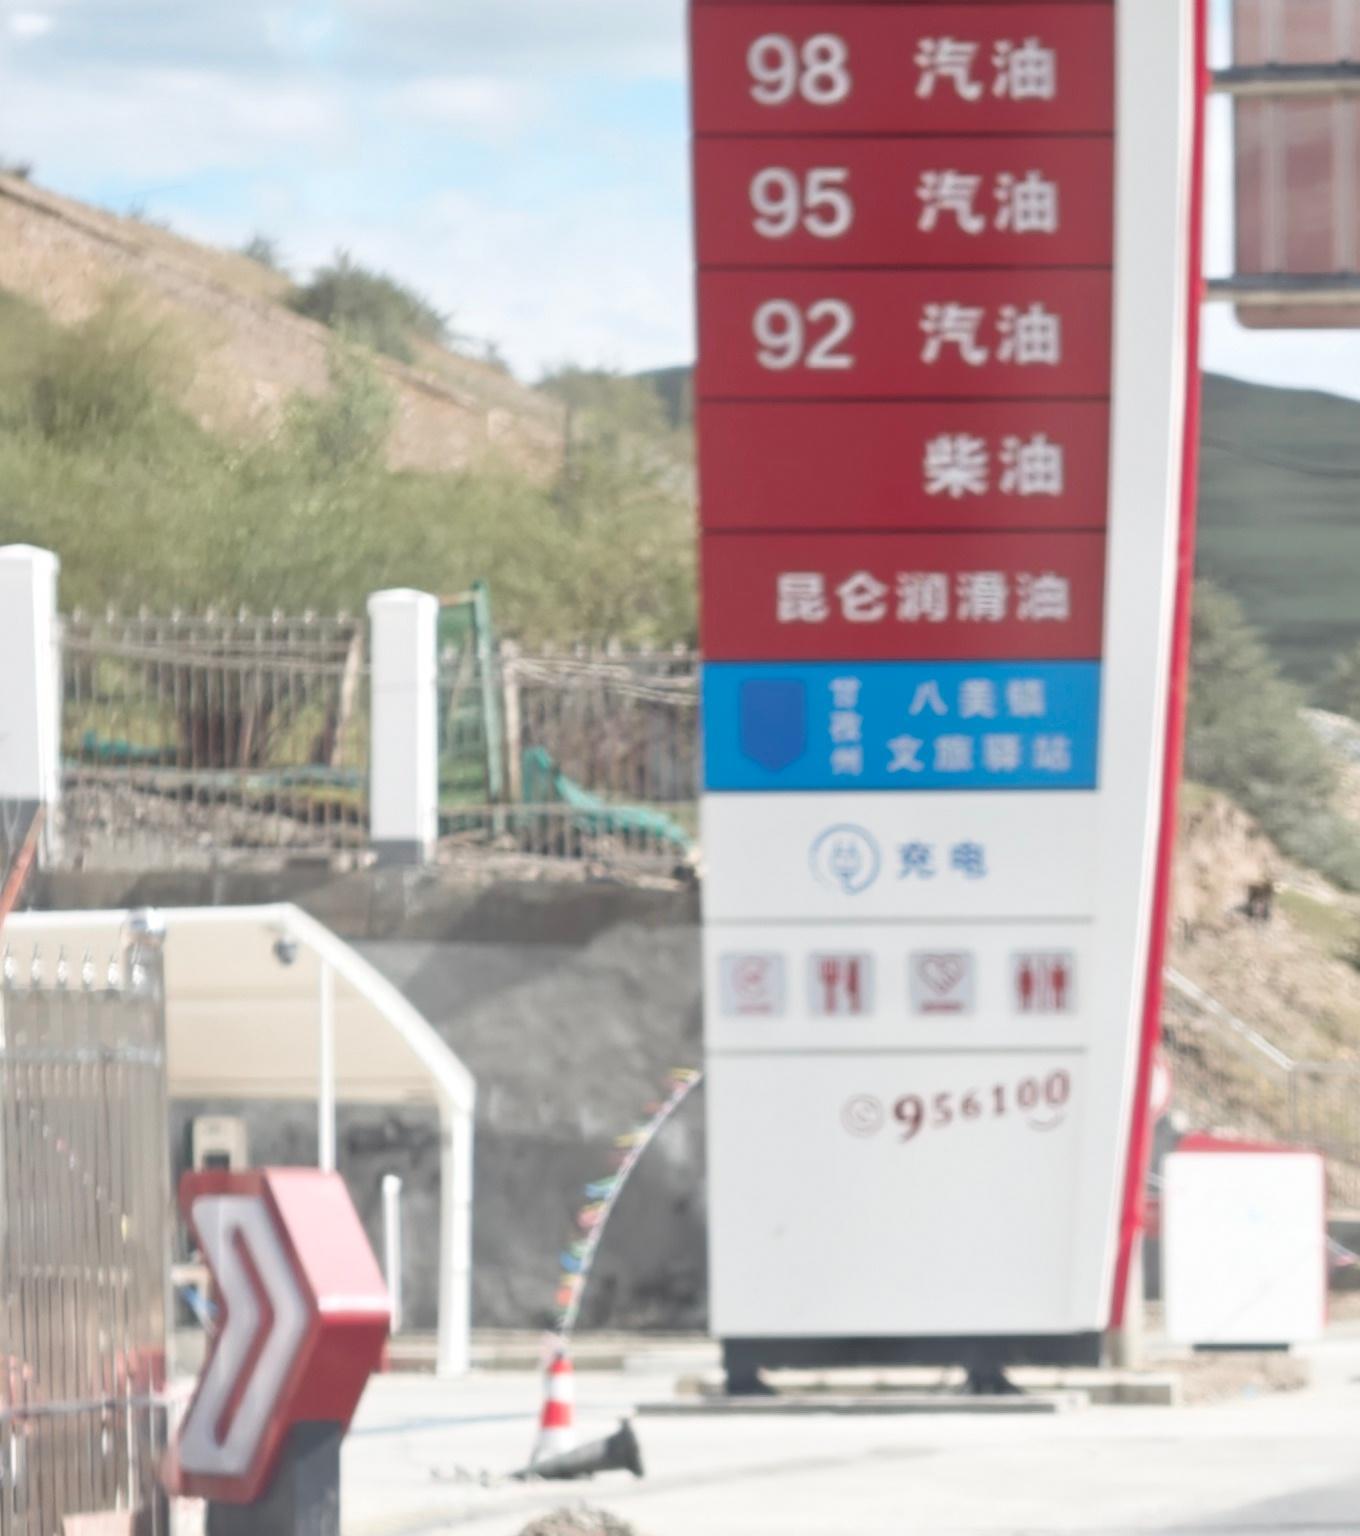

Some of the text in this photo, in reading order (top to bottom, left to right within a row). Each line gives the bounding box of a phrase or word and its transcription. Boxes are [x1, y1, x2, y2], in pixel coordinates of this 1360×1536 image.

[745, 33, 1057, 105] 98 汽油
[749, 167, 1059, 239] 95 汽油
[752, 298, 1061, 370] 92 汽油
[922, 432, 1064, 499] 柴油
[775, 571, 1072, 623] 昆仑润滑油
[896, 840, 989, 881] 充电
[892, 1068, 1071, 1144] 956100
